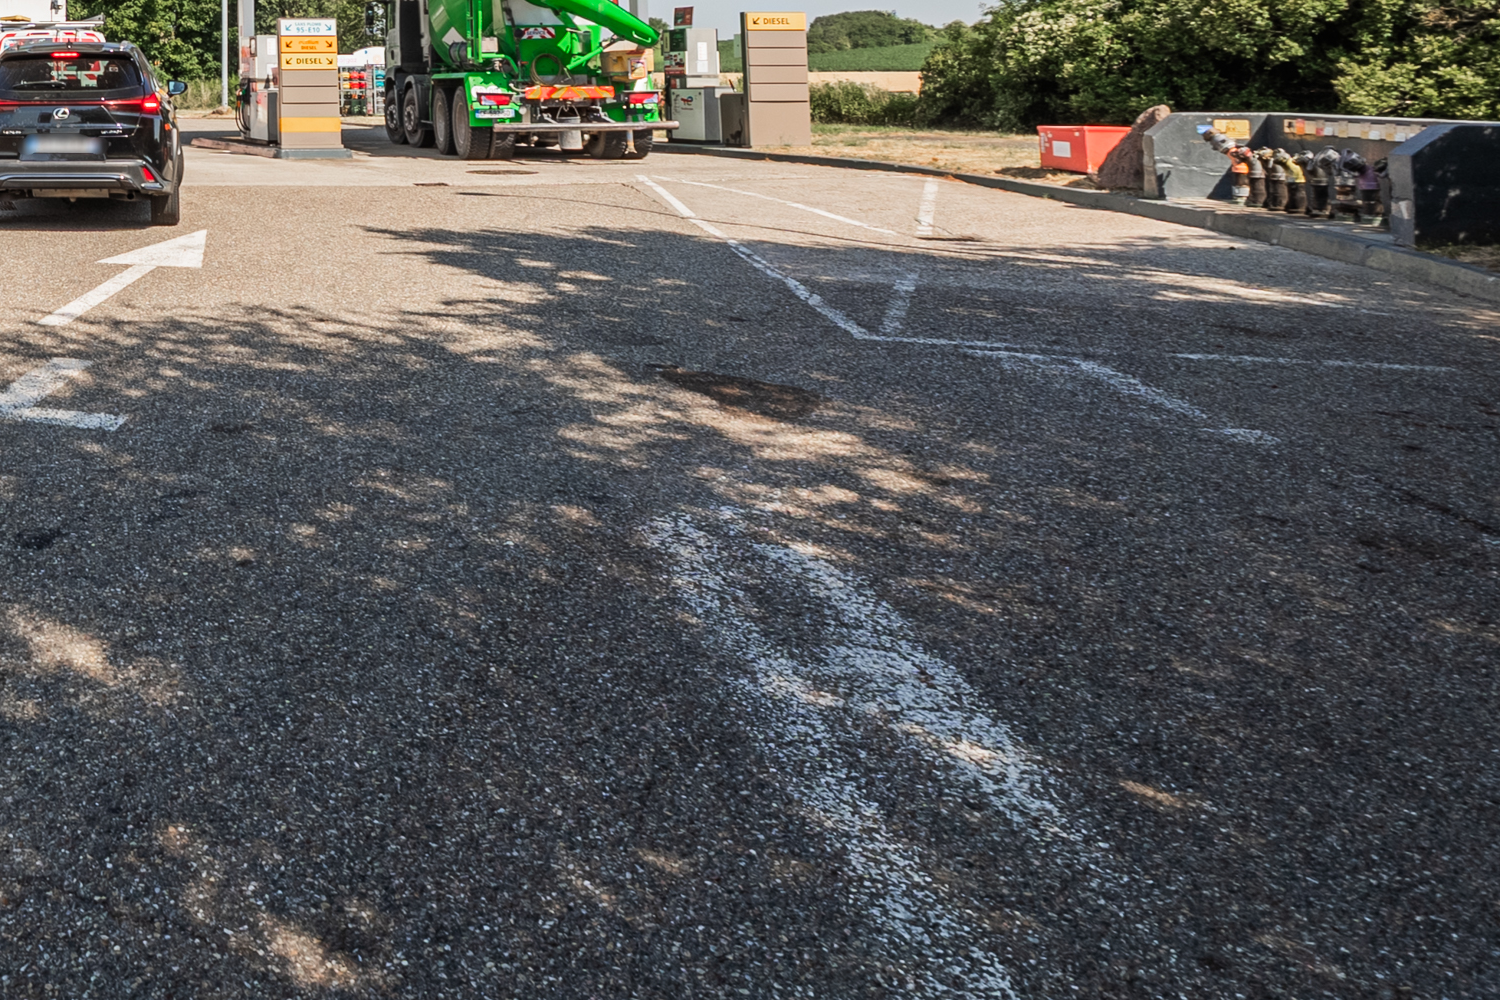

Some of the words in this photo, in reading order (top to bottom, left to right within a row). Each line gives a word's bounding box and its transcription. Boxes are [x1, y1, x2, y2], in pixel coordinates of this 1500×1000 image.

[763, 17, 790, 25] DIESEL
[296, 26, 322, 34] 95-E10
[296, 57, 323, 65] DIESEL
